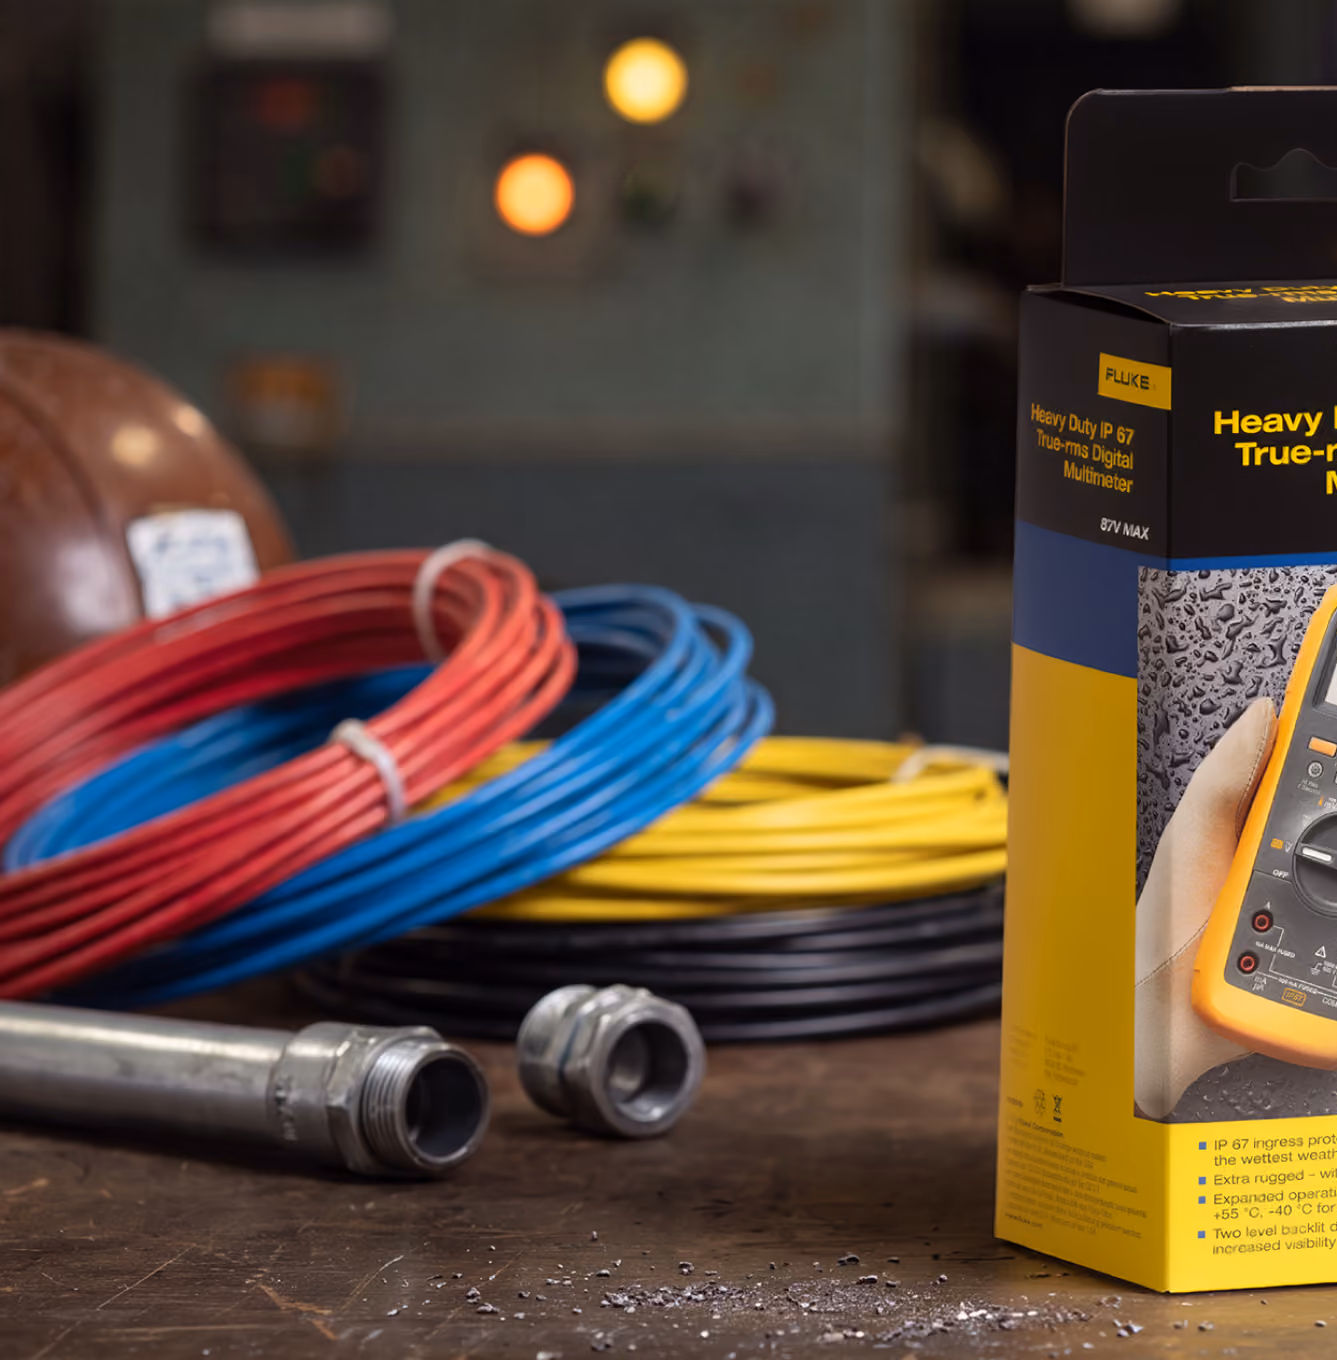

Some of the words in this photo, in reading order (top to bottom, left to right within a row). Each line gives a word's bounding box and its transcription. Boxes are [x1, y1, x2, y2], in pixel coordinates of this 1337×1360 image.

[1106, 367, 1149, 390] FLUKE
[1031, 402, 1066, 432] Heavy
[1069, 414, 1096, 440] Duty
[1101, 420, 1113, 439] IP
[1117, 426, 1135, 445] 67
[1214, 410, 1322, 437] Heavy
[1037, 428, 1088, 459] True-rms
[1092, 444, 1133, 469] Digital
[1064, 460, 1133, 493] Multimeter
[1100, 517, 1121, 533] 87V
[1123, 522, 1149, 540] MAX
[1273, 869, 1288, 878] OFF
[1214, 1140, 1228, 1152] IP
[1233, 1138, 1248, 1150] 67
[1253, 1136, 1303, 1152] ingress
[1214, 1155, 1236, 1166] the
[1241, 1152, 1293, 1165] wettest
[1214, 1174, 1250, 1185] Extra
[1255, 1172, 1304, 1185] rugged
[1214, 1191, 1283, 1206] Expanded
[1214, 1208, 1239, 1220] +55
[1317, 1202, 1335, 1214] for
[1213, 1228, 1241, 1240] Two
[1246, 1225, 1277, 1237] level
[1282, 1223, 1325, 1236] backlit
[1213, 1240, 1281, 1255] increased
[1285, 1237, 1336, 1251] visibility
